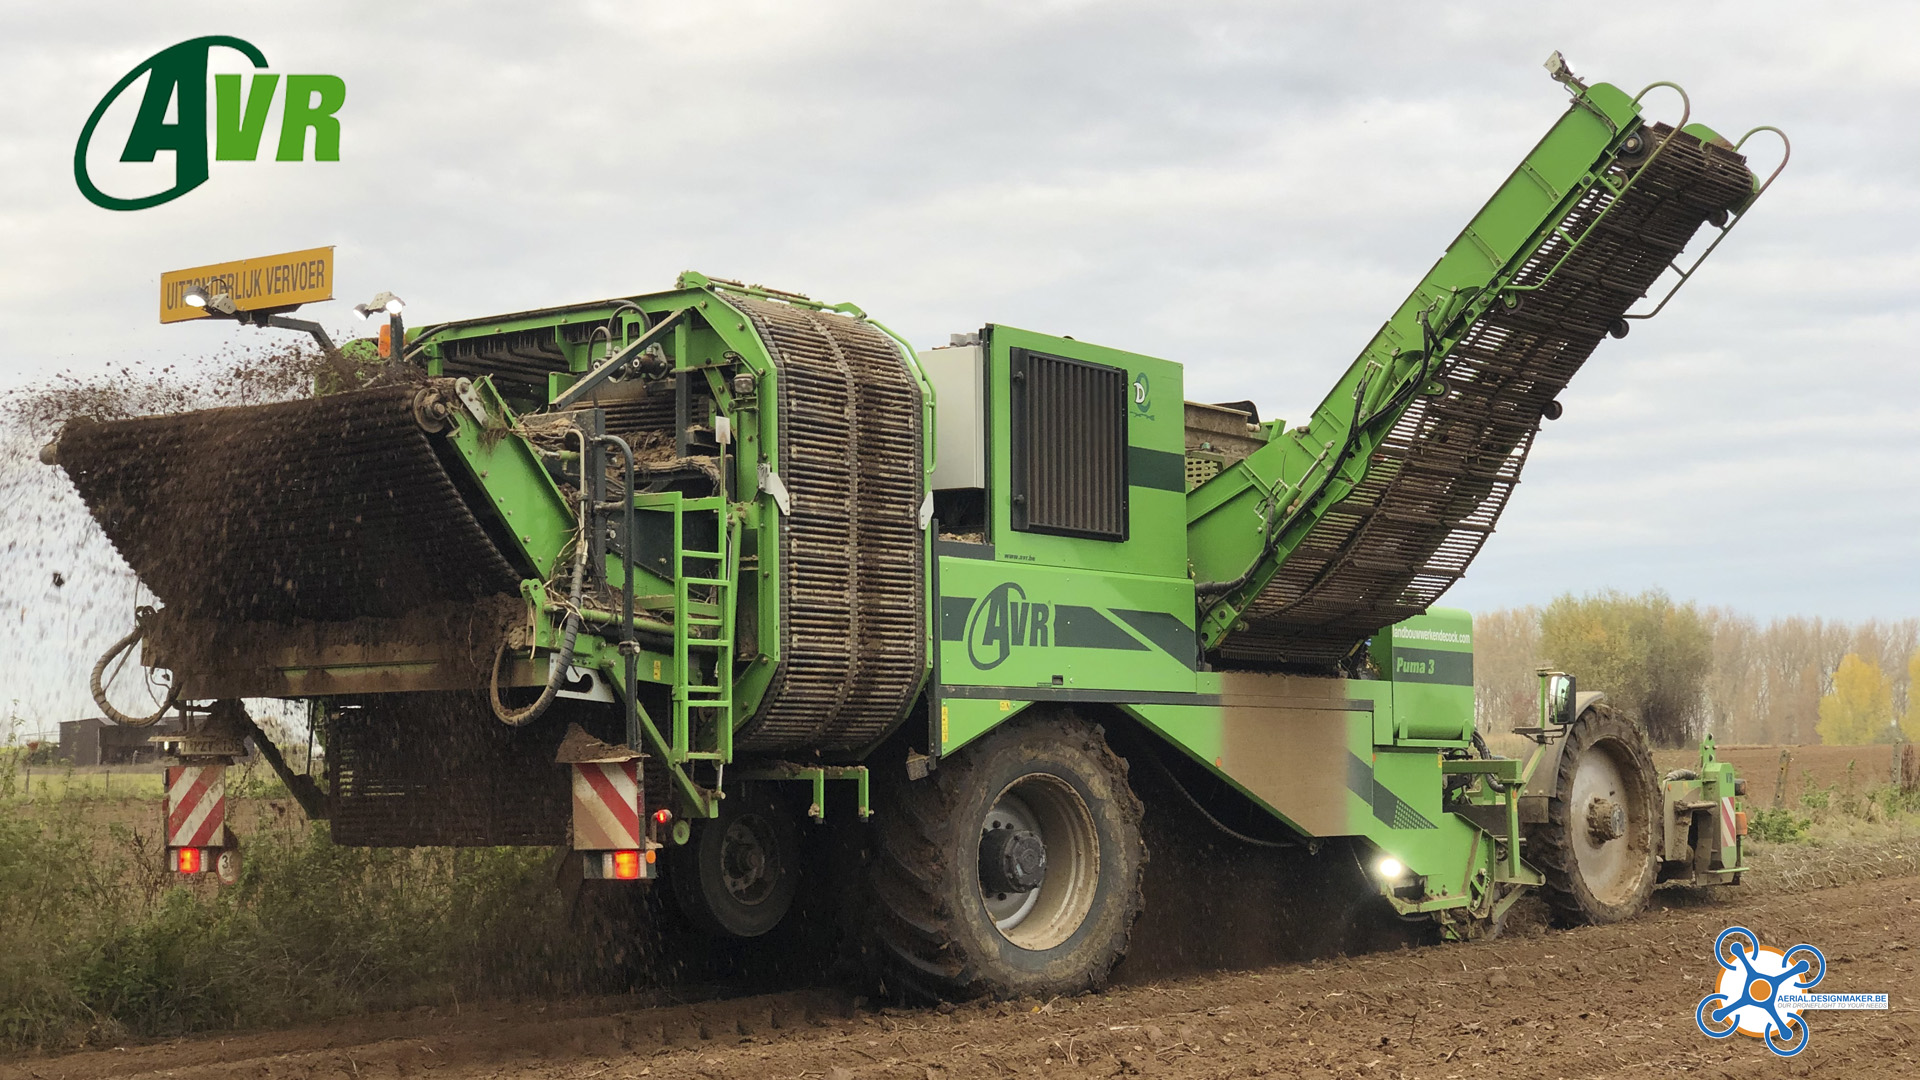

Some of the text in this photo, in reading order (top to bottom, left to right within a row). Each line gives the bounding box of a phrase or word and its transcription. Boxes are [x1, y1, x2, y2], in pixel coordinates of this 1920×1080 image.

[166, 259, 325, 310] UITNDERLIJK VERVOER
[1004, 553, 1036, 562] www.avr.be
[968, 582, 1049, 671] AVR
[1392, 625, 1471, 644] landbouwwerkendecock.com
[1397, 656, 1435, 675] Puma 3
